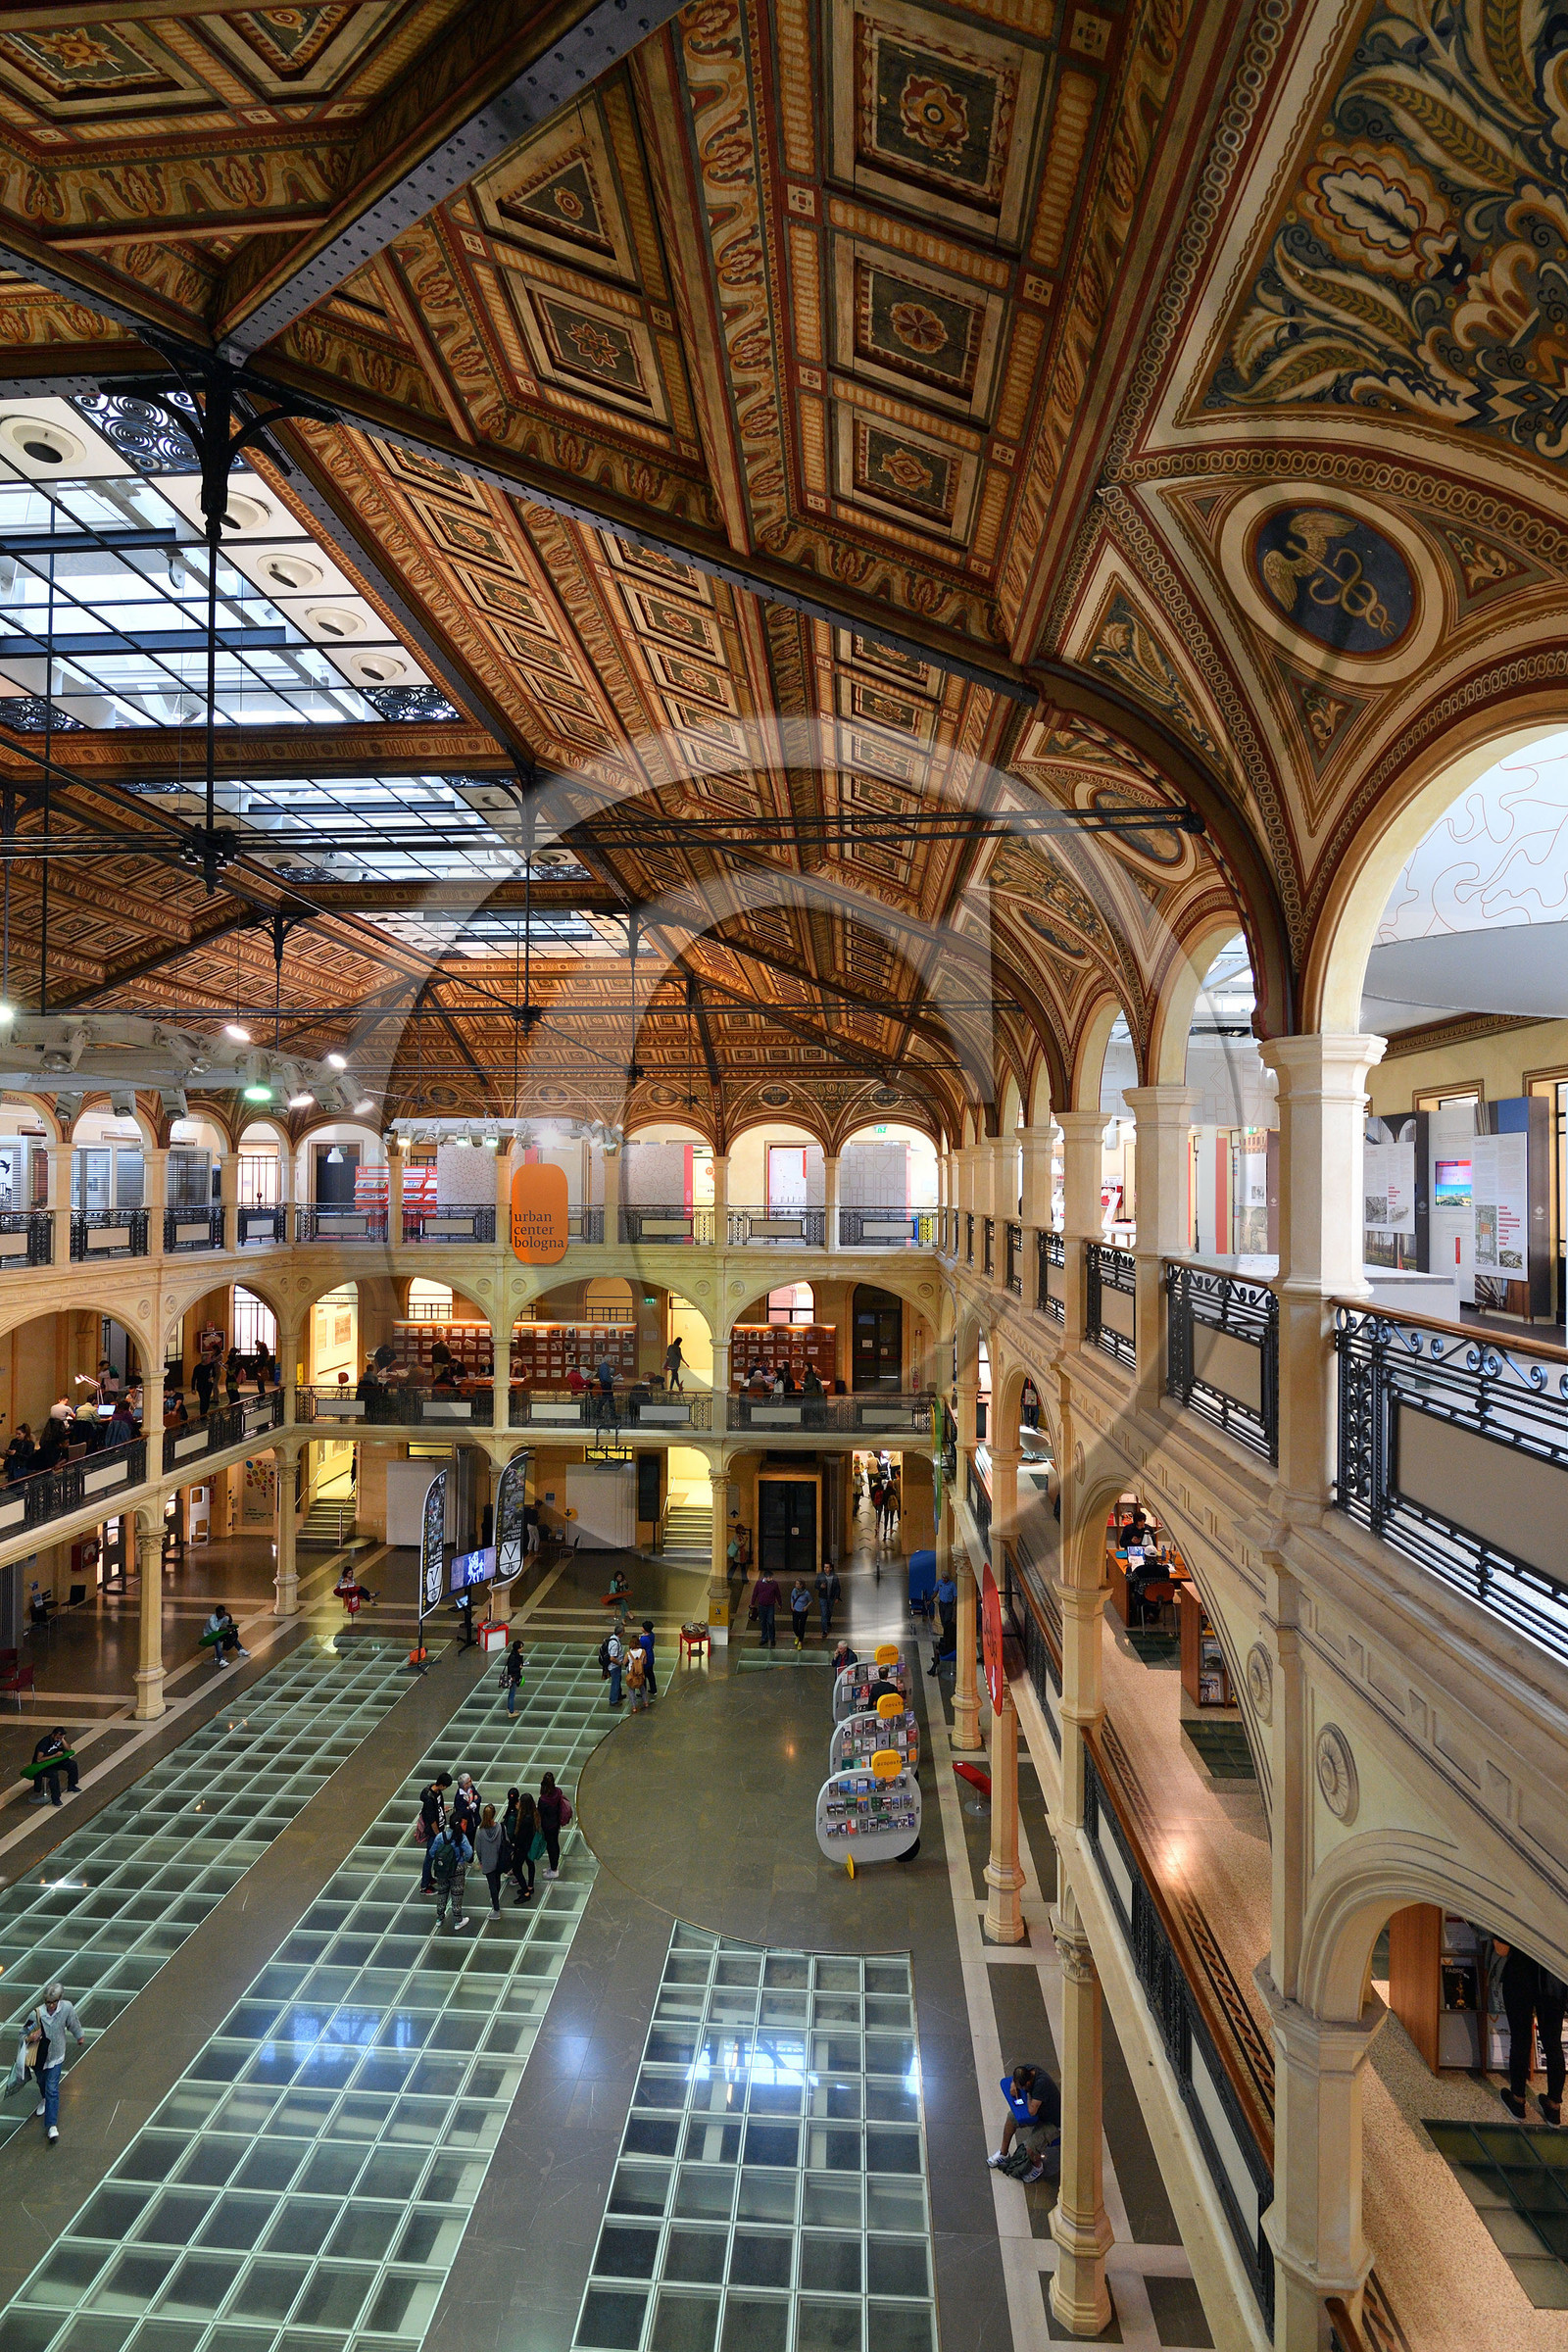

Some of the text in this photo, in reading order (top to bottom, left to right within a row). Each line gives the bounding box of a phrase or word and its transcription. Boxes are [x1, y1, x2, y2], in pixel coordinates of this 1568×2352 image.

[514, 1209, 552, 1222] urban
[514, 1224, 555, 1236] center
[514, 1236, 564, 1251] bologna
